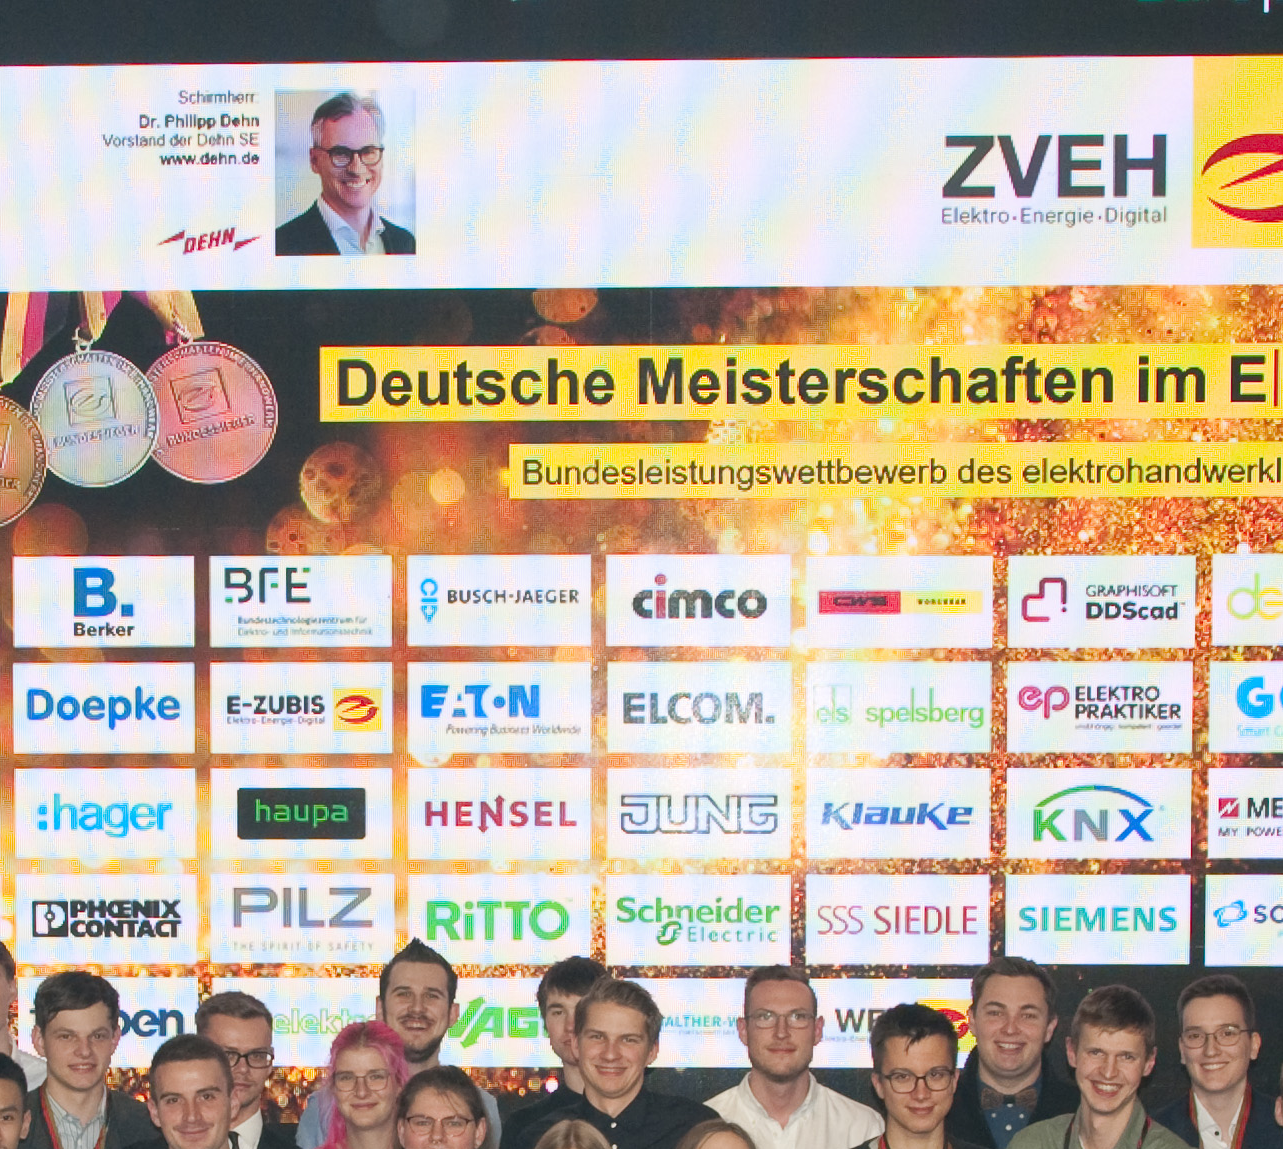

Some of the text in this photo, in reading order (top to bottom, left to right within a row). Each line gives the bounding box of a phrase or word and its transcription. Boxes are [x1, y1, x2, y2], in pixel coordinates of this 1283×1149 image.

[139, 113, 160, 129] Dr.
[220, 112, 260, 127] Dehn
[239, 132, 260, 146] SE
[942, 134, 1167, 198] ZVEH
[183, 226, 236, 255] DEHN
[337, 358, 614, 407] Deutsche
[638, 354, 1115, 406] Meisterschaften
[1137, 354, 1207, 404] im
[522, 458, 947, 488] Bundesleistungswettbewerb
[957, 458, 1013, 486] des
[225, 567, 312, 603] BFE
[447, 589, 580, 604] BUSCH-JAEGER
[632, 574, 767, 618] cimco
[1086, 585, 1178, 597] GRAPHISOFT
[1086, 602, 1179, 620] DDScad
[74, 623, 135, 636] Berker
[226, 695, 325, 715] E-ZUBIS
[865, 687, 985, 728] spelsberg
[1075, 686, 1160, 701] ELEKTRO
[26, 686, 180, 731] Doepke
[1075, 704, 1181, 719] PRAKTIKER
[254, 798, 349, 827] haupa
[425, 796, 577, 832] HENSEL
[621, 794, 778, 834] JUNG
[1033, 808, 1154, 842] KNX
[1218, 827, 1238, 837] MY
[233, 887, 373, 928] PILZ
[617, 896, 781, 924] Schneider
[873, 905, 978, 935] SIEDLE
[1019, 906, 1178, 932] SIEMENS
[70, 920, 181, 938] CONTACT
[688, 926, 777, 943] Electric
[233, 943, 255, 951] THE
